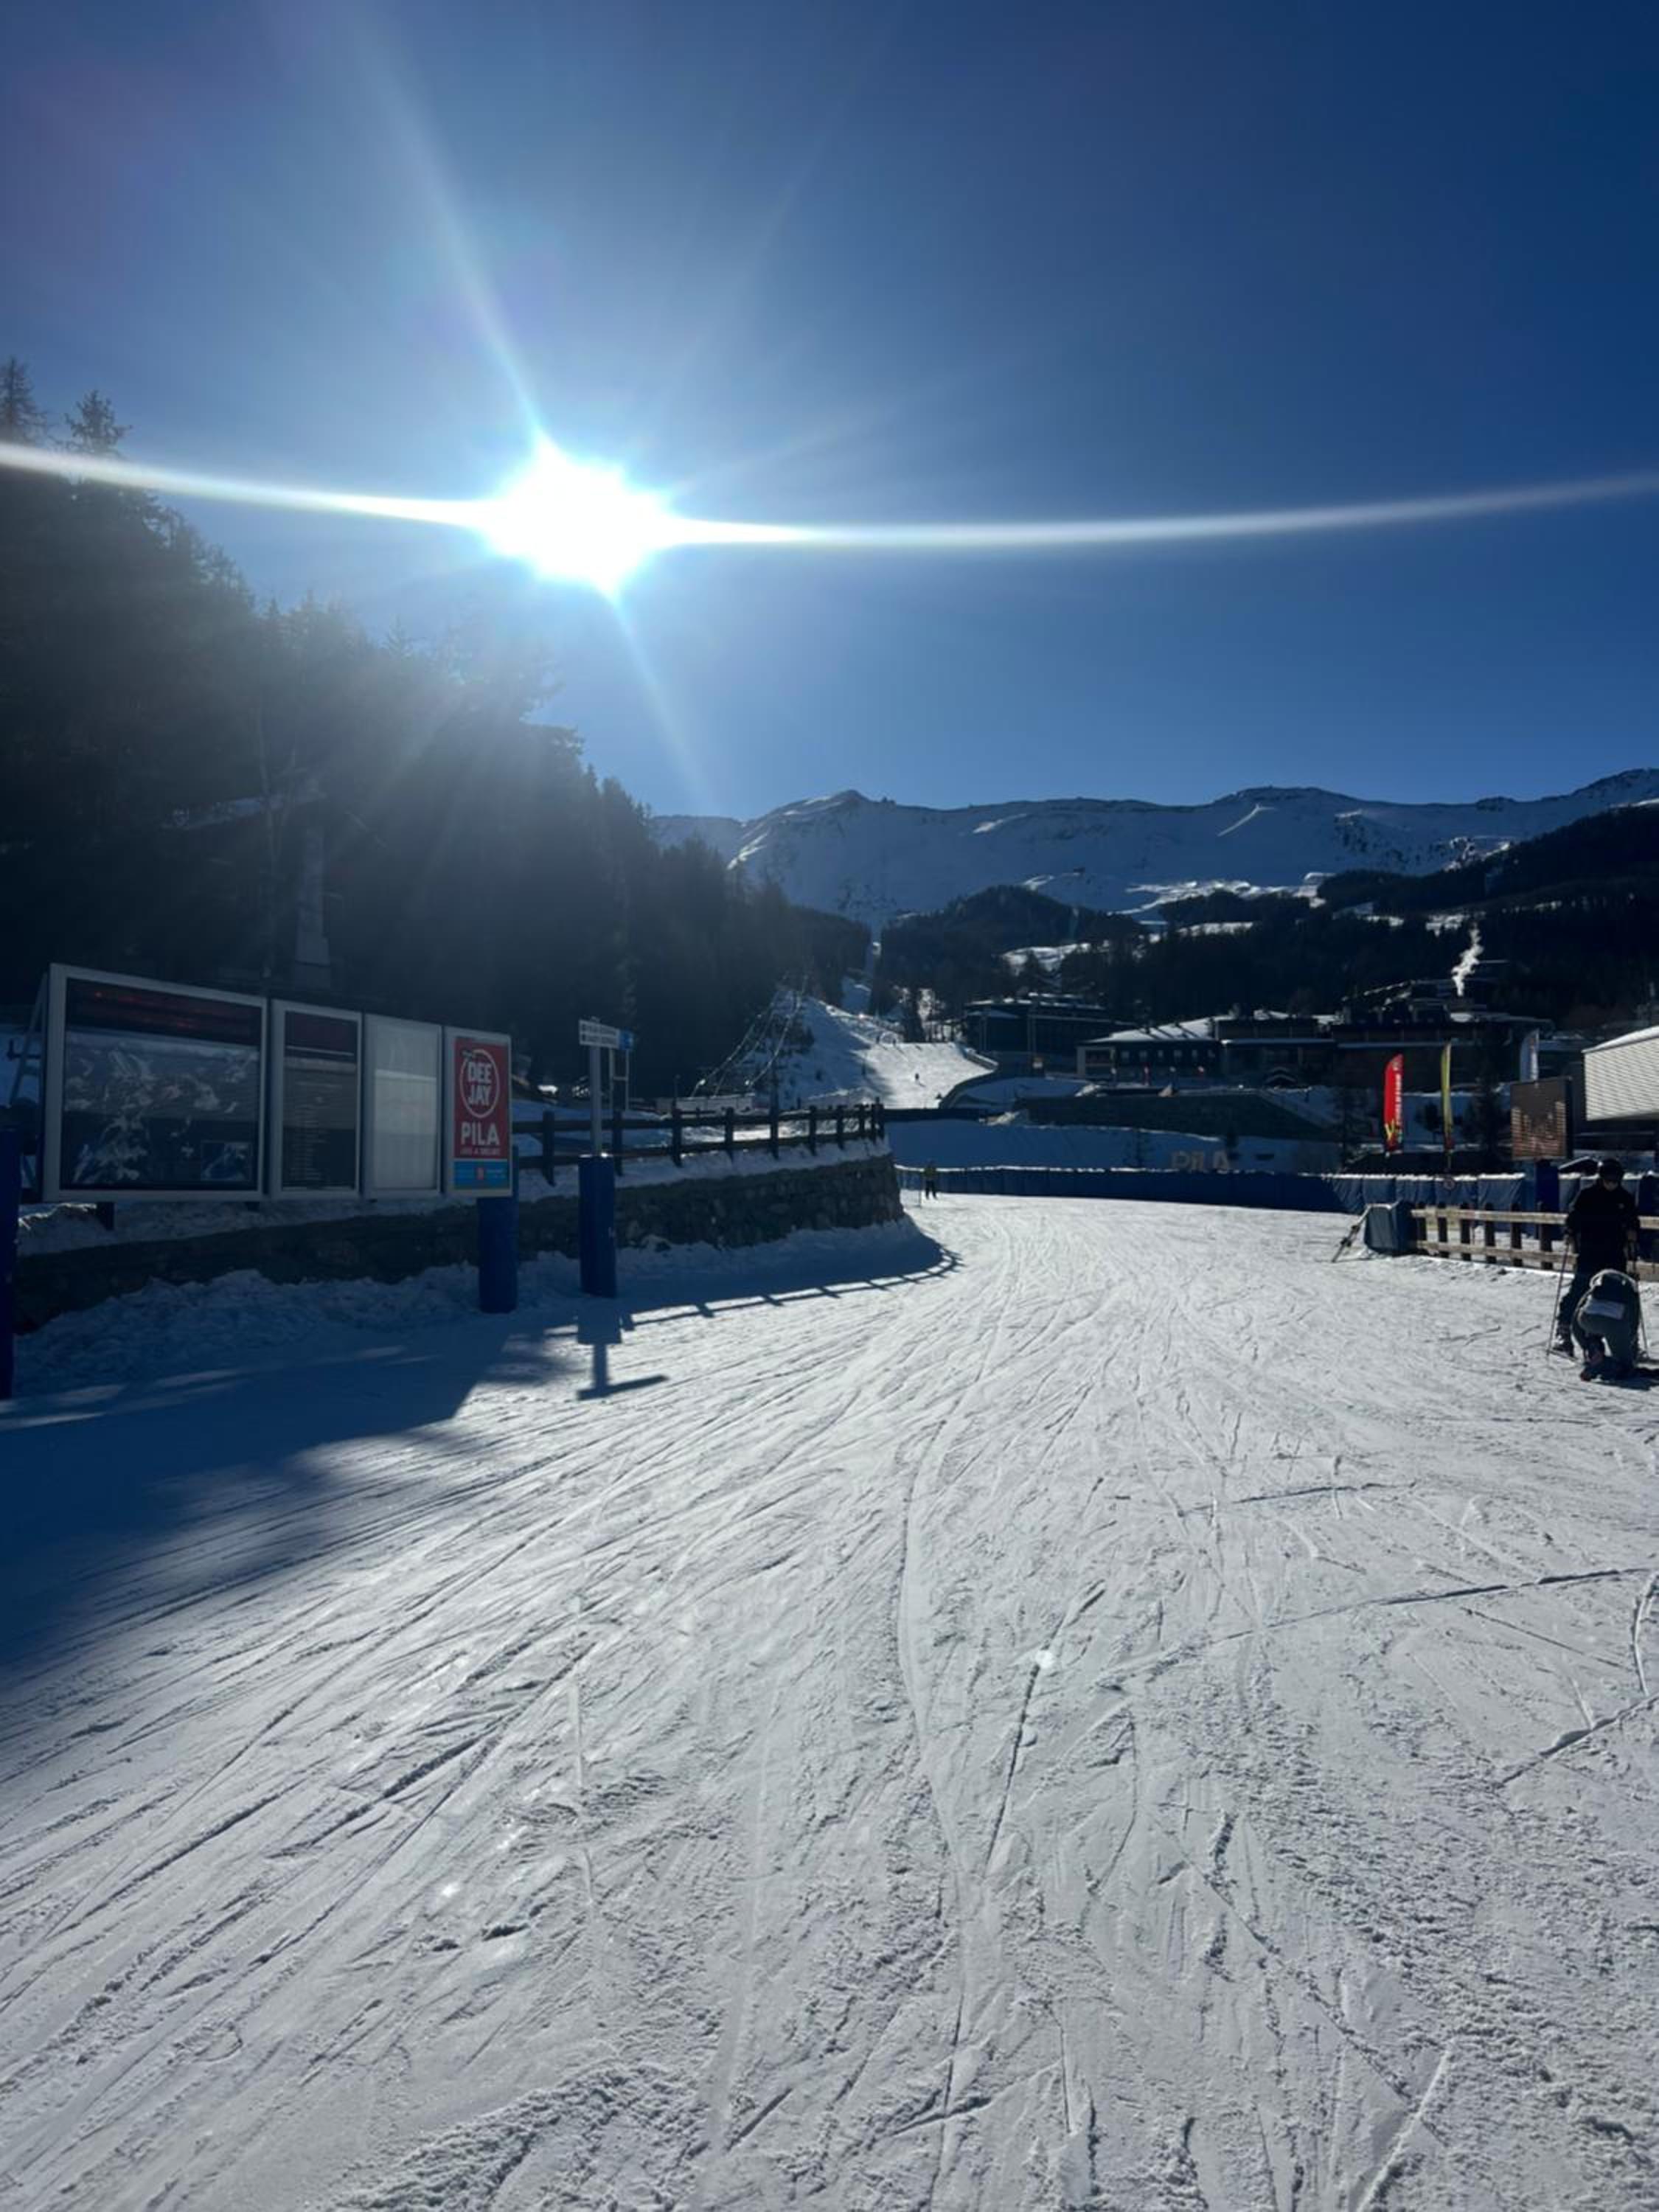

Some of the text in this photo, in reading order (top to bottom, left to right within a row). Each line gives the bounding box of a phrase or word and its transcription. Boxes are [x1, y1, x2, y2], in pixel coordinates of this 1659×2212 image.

[467, 1060, 493, 1084] DEE
[467, 1084, 492, 1106] JAY
[460, 1121, 501, 1146] PILA
